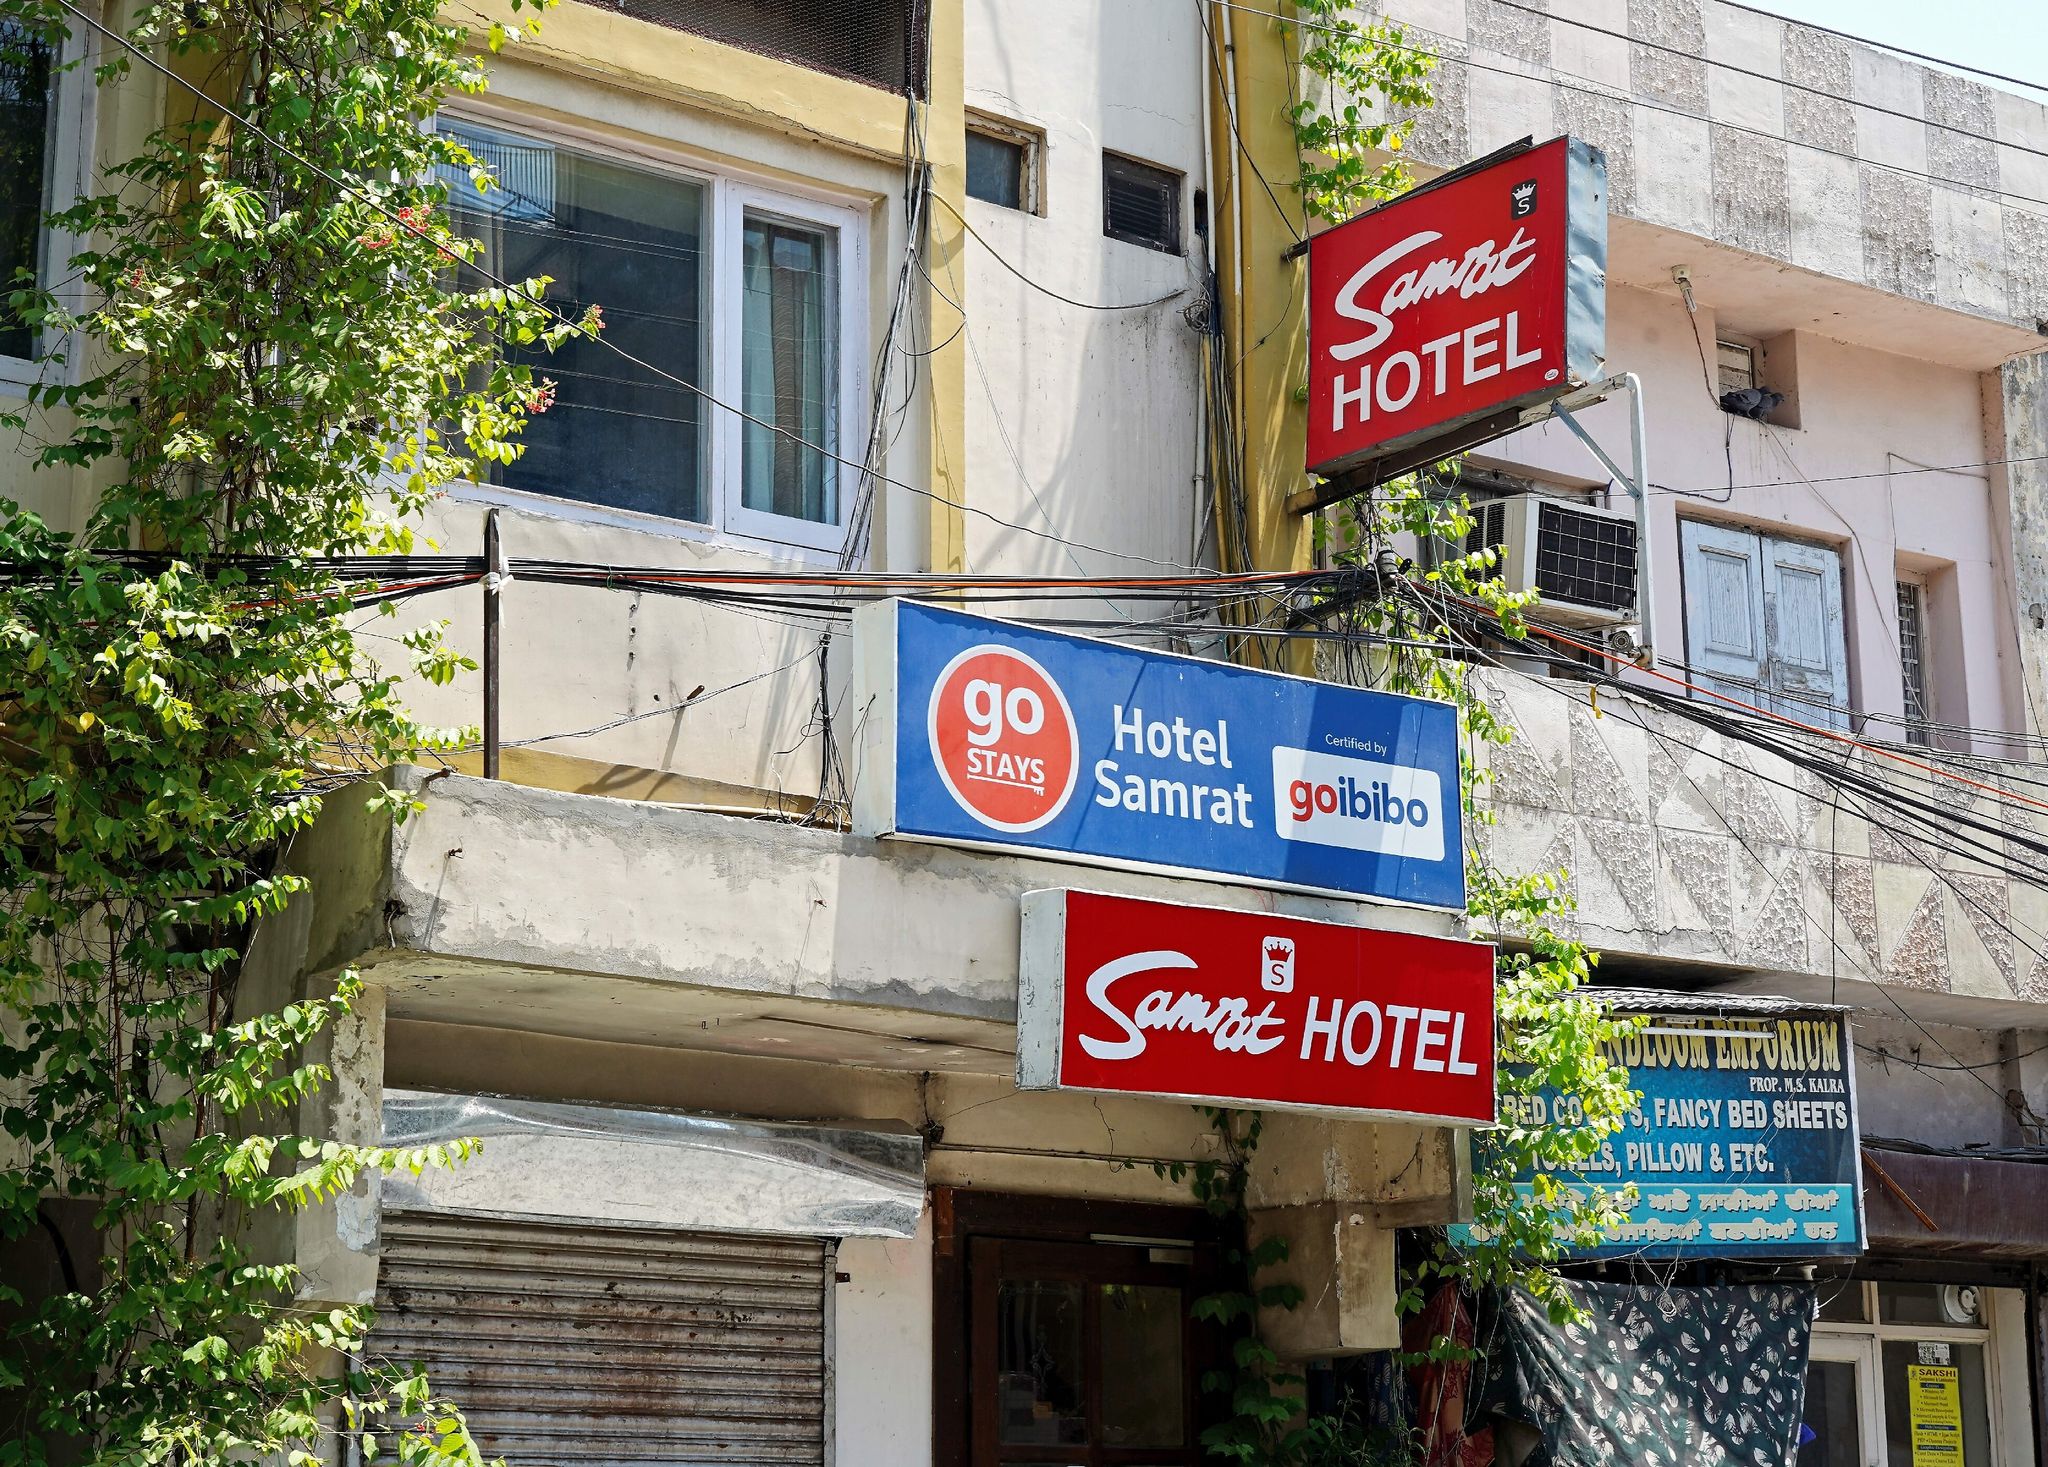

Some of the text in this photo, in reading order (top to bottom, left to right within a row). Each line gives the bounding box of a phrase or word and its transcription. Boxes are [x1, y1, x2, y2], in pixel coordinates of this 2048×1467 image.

[1333, 310, 1542, 432] HOTEL
[963, 678, 1045, 746] go
[1114, 704, 1232, 769] Hotel
[967, 747, 1045, 785] STAYS
[1325, 732, 1388, 757] Certified by
[1095, 760, 1253, 828] Samrat
[1289, 776, 1429, 828] goibibo
[1300, 996, 1477, 1075] HOTEL
[1713, 1018, 1841, 1072] EMPORIUM
[1749, 1077, 1782, 1093] PROP.
[1808, 1078, 1845, 1094] KALRA
[1503, 1094, 1547, 1126] BED
[1653, 1098, 1723, 1128] FANCY
[1728, 1100, 1768, 1129] BED
[1773, 1100, 1848, 1130] SHEETS
[1625, 1142, 1702, 1172] PILLOW
[1709, 1143, 1725, 1172] &
[1728, 1143, 1775, 1172] ETC.
[1919, 1368, 1957, 1378] SAKSHI
